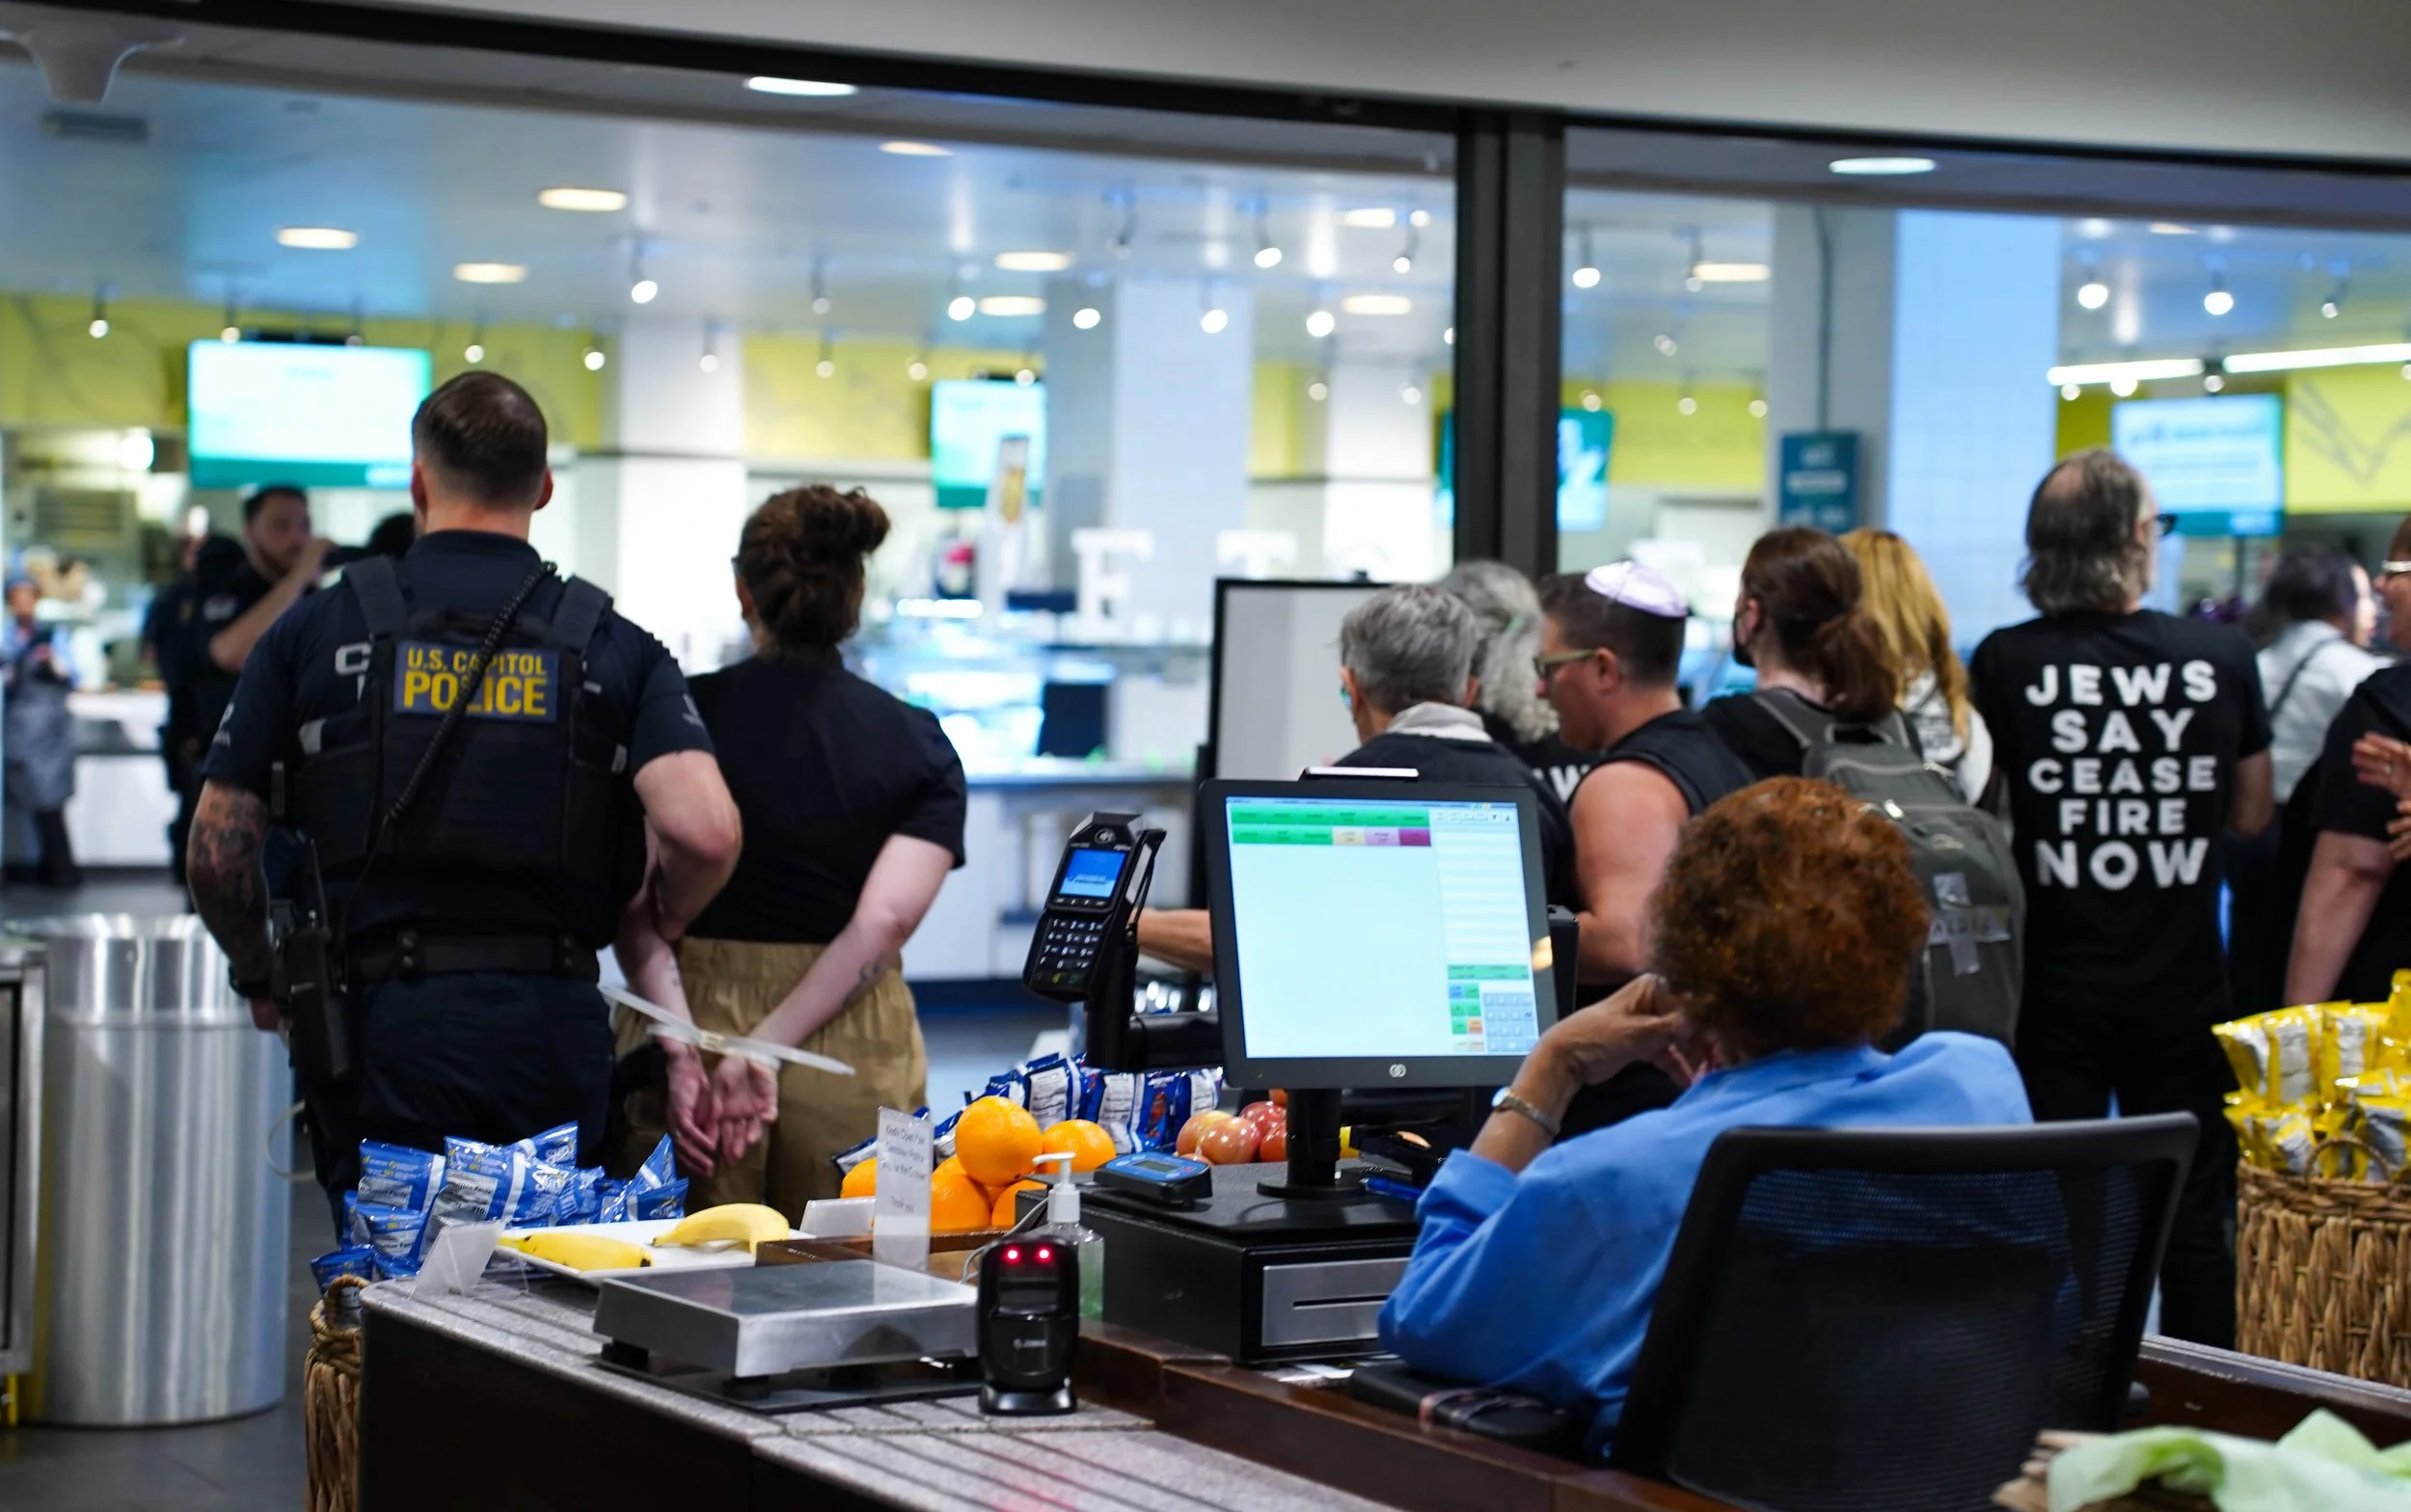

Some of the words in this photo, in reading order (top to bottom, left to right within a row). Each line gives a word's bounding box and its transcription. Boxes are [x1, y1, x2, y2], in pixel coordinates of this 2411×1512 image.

[407, 647, 447, 670] U.S.
[403, 670, 547, 716] POICE
[2025, 660, 2217, 706] JEWS
[2051, 707, 2195, 753] SAY
[2028, 756, 2217, 794] CEASE
[2059, 797, 2186, 836] FIRE
[2035, 837, 2209, 891] NOW
